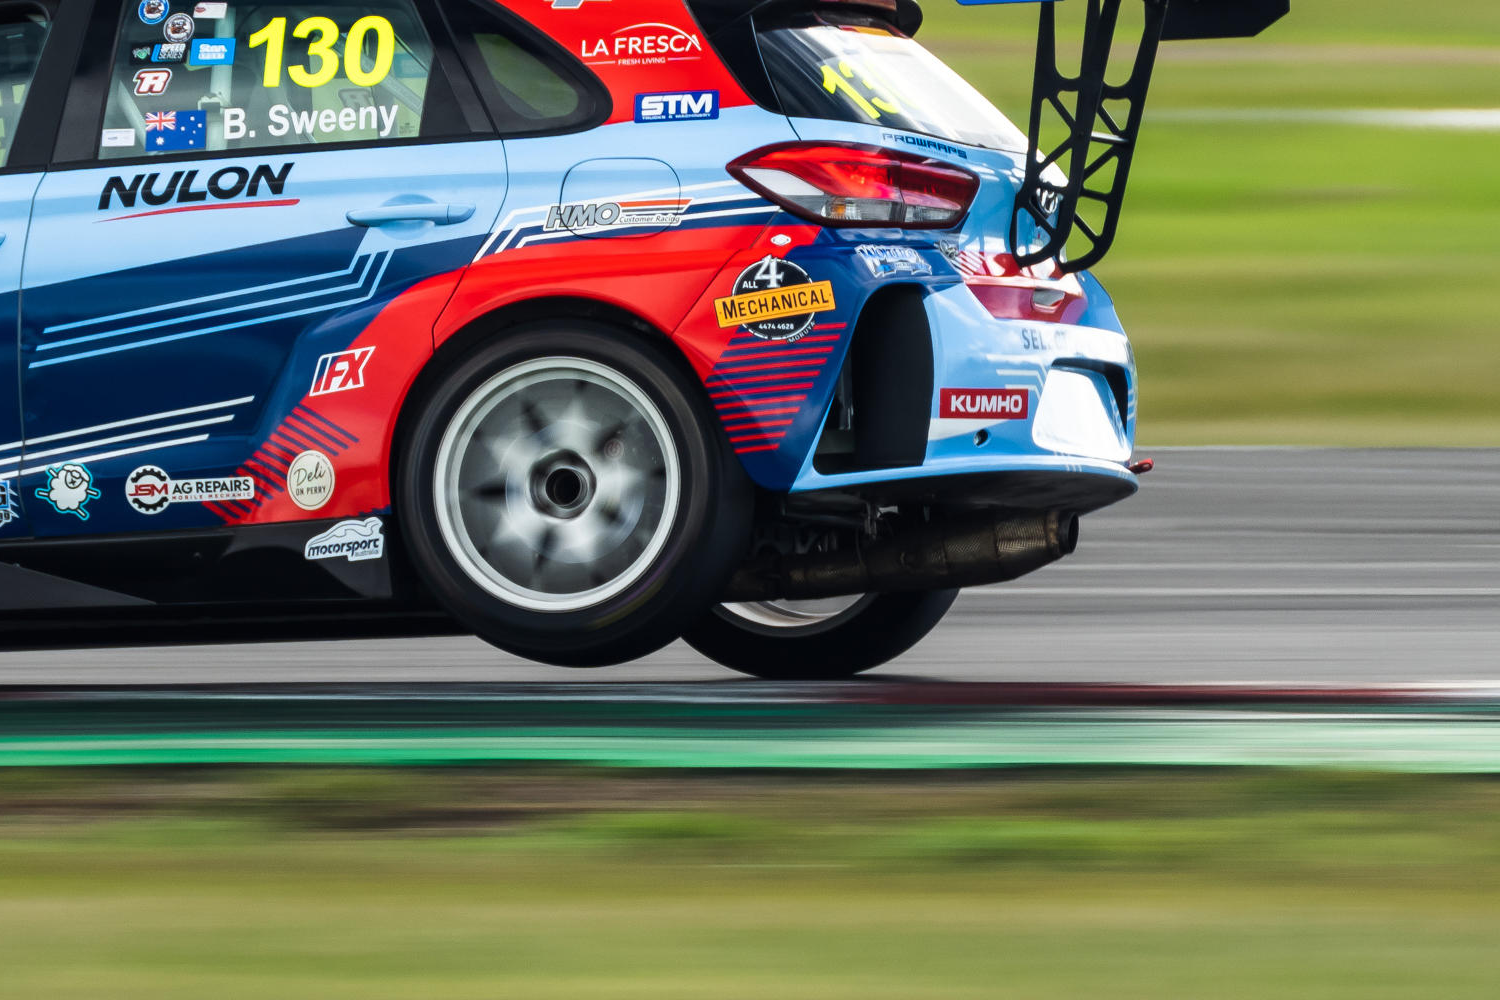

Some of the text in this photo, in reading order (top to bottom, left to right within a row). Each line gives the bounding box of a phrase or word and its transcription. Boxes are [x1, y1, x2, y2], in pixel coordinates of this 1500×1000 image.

[158, 51, 183, 60] SERIES
[160, 43, 186, 52] SPEED
[248, 15, 396, 88] 130
[581, 34, 702, 57] LA FRESCA
[618, 57, 666, 66] FRESH LIVING
[641, 93, 713, 116] STM
[223, 104, 399, 140] B. Sweeny
[882, 133, 968, 160] PROWRAPS
[97, 162, 296, 210] NULON
[545, 202, 621, 229] HMO
[619, 214, 680, 223] Customer Racing
[742, 254, 785, 289] ALL 4
[721, 289, 830, 320] MECHANICAL
[788, 321, 816, 343] MORUYA
[1021, 328, 1068, 350] SELCT
[950, 394, 1023, 413] KUMHO
[294, 461, 327, 487] Deli
[128, 483, 169, 497] JSM
[172, 479, 250, 495] AG REPAIRS
[295, 485, 327, 496] ON PERRY
[307, 537, 380, 558] motorsport
[354, 548, 380, 558] australia
